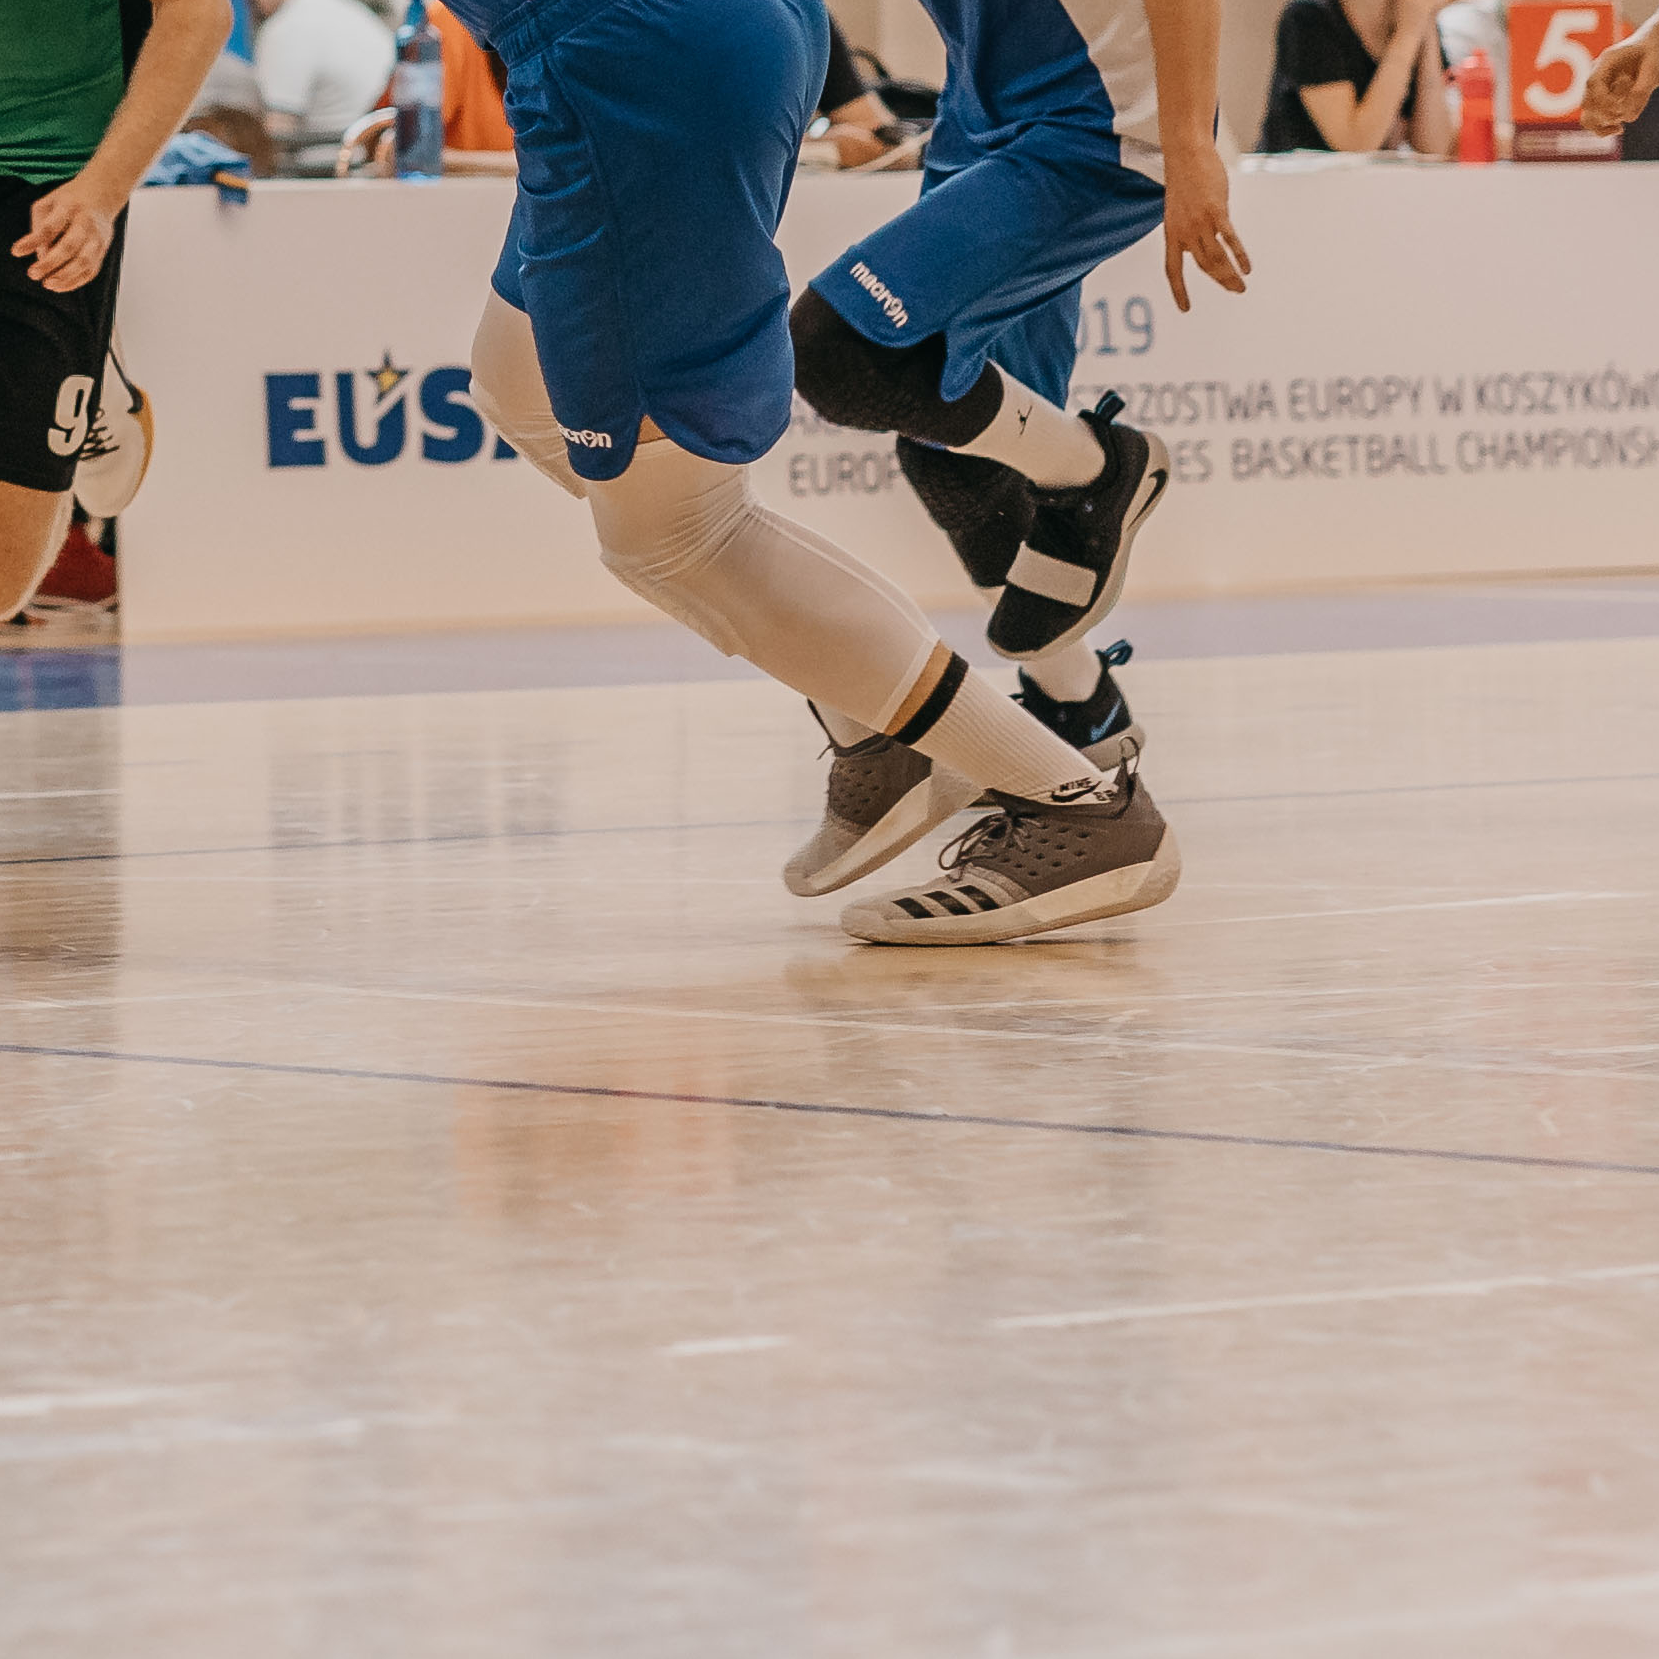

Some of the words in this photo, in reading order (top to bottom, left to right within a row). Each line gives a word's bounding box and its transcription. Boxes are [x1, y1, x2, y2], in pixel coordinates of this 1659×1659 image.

[1523, 8, 1599, 117] 5
[849, 261, 909, 329] macron
[47, 374, 96, 457] 9
[263, 351, 519, 468] EUS
[1290, 373, 1424, 423] EUROPY
[1432, 373, 1466, 418] W
[1228, 429, 1450, 483] BASKETBALL
